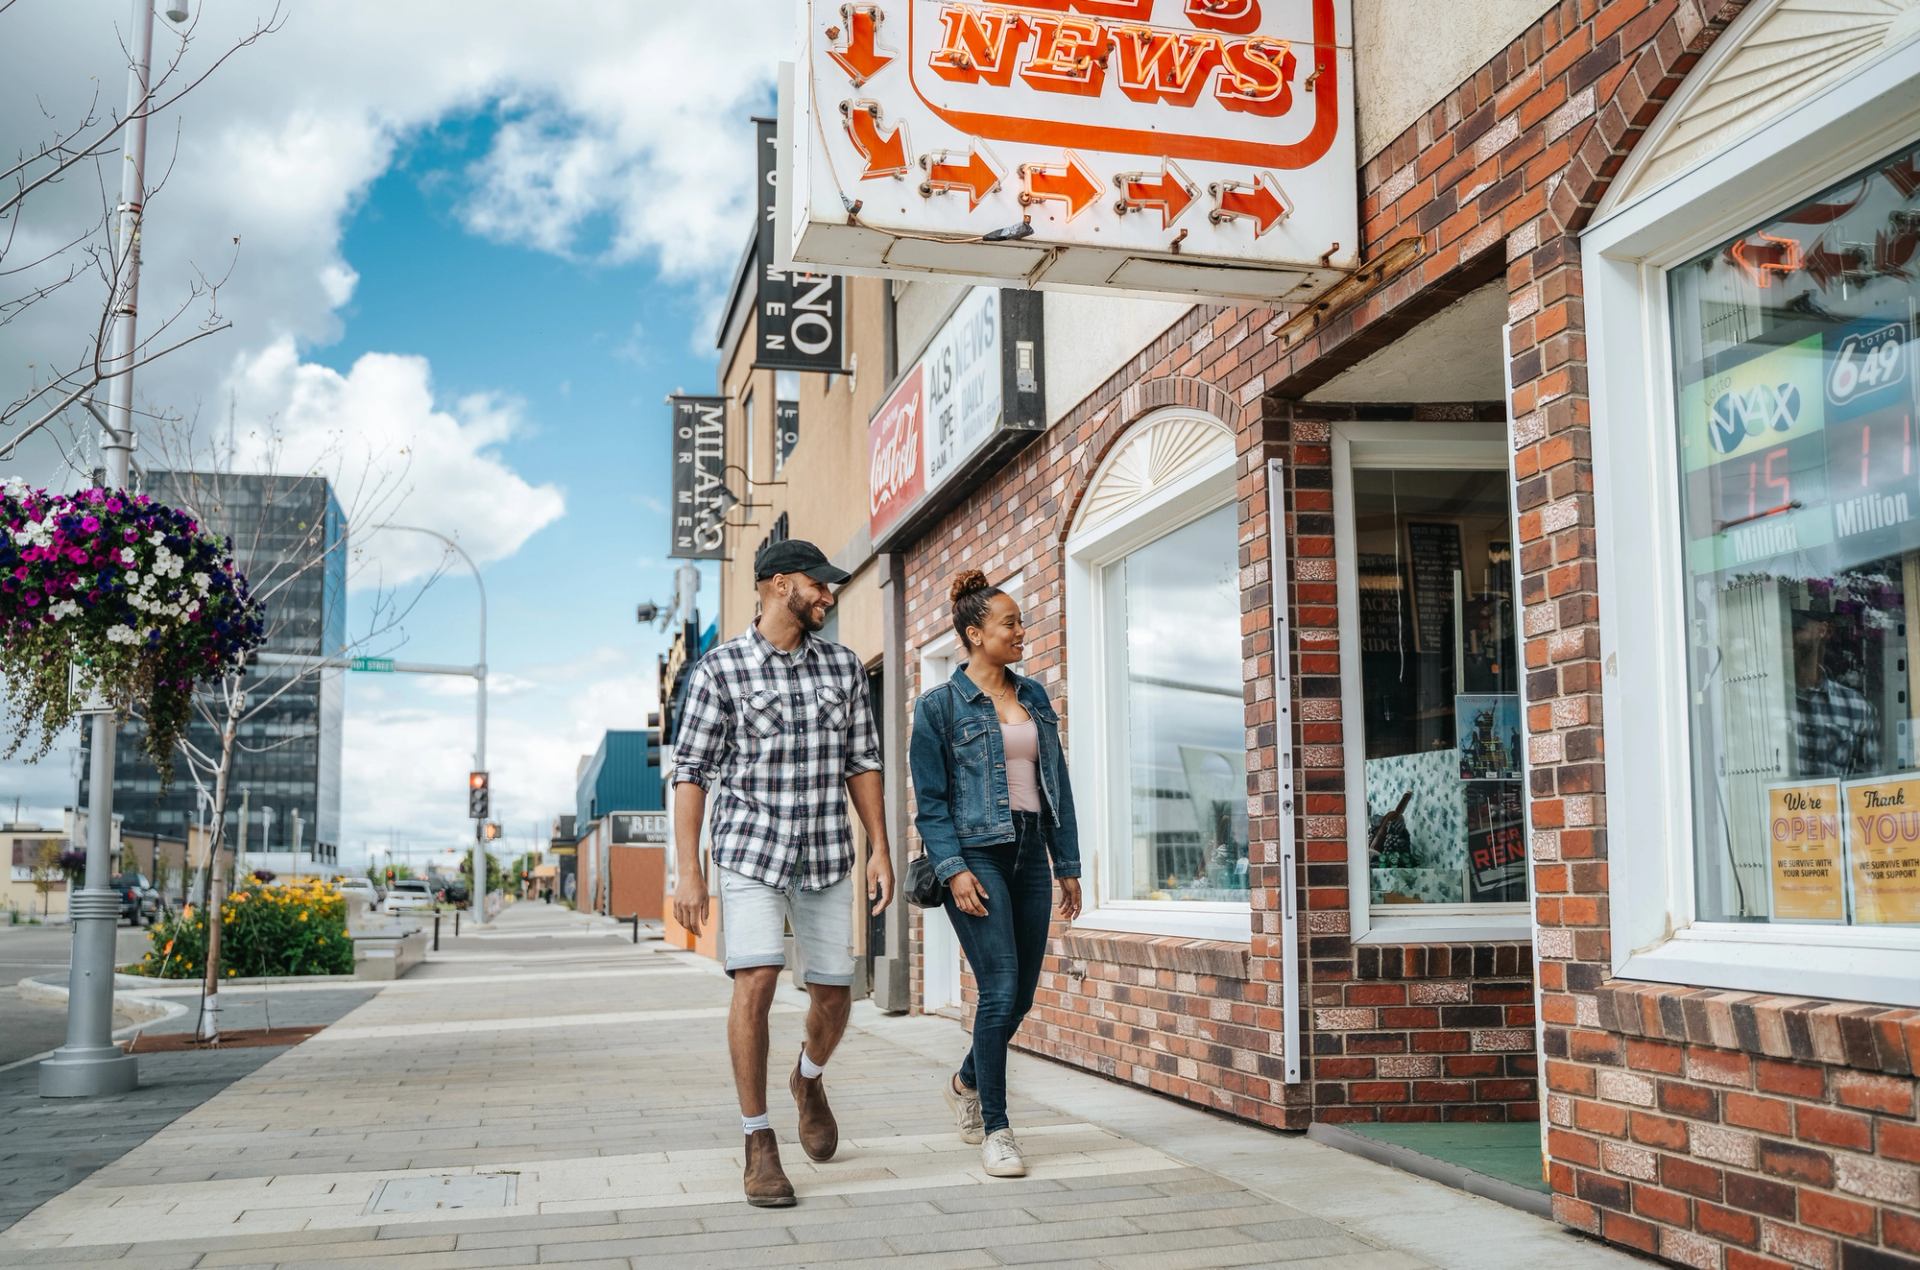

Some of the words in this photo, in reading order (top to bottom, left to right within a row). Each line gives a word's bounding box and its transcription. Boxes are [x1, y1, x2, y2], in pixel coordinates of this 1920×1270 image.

[927, 4, 1297, 117] NEWS
[766, 264, 786, 350] MEN
[955, 295, 995, 382] NEWS
[1860, 328, 1896, 348] LOTTO
[678, 404, 693, 464] FOR
[938, 404, 955, 445] OPE
[1708, 382, 1801, 454] MAX
[678, 491, 693, 548] MEN
[1836, 491, 1909, 538] Million
[1733, 522, 1798, 562] Million
[1784, 792, 1822, 811] We're
[1864, 788, 1905, 809] Thank
[1772, 814, 1838, 842] OPEN
[1857, 811, 1920, 845] YOU
[1472, 840, 1525, 870] REN
[1789, 859, 1814, 867] SURVIVE
[1815, 859, 1832, 867] WITH
[1859, 862, 1870, 870] WE
[1871, 860, 1901, 869] SURVIVE
[1902, 859, 1920, 867] WITH
[1783, 869, 1800, 878] YOUR
[1801, 869, 1829, 878] SUPPORT
[1866, 871, 1884, 880] YOUR
[1885, 870, 1917, 879] SUPPORT
